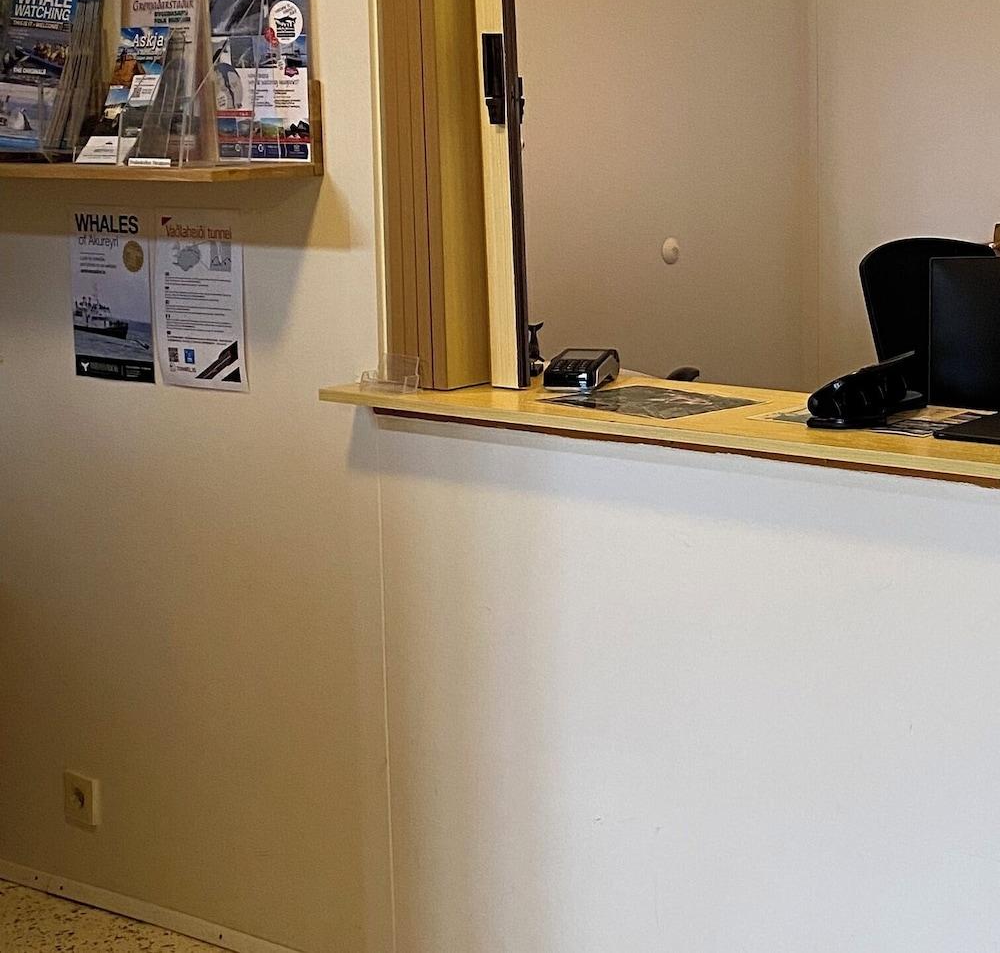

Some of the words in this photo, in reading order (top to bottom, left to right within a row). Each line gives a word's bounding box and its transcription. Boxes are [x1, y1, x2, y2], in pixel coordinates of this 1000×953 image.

[14, 3, 71, 21] WATCHING
[133, 32, 164, 51] Askja
[75, 213, 139, 235] WHALES
[207, 226, 232, 240] tunnel
[78, 236, 87, 245] of
[88, 237, 119, 250] Akureyri
